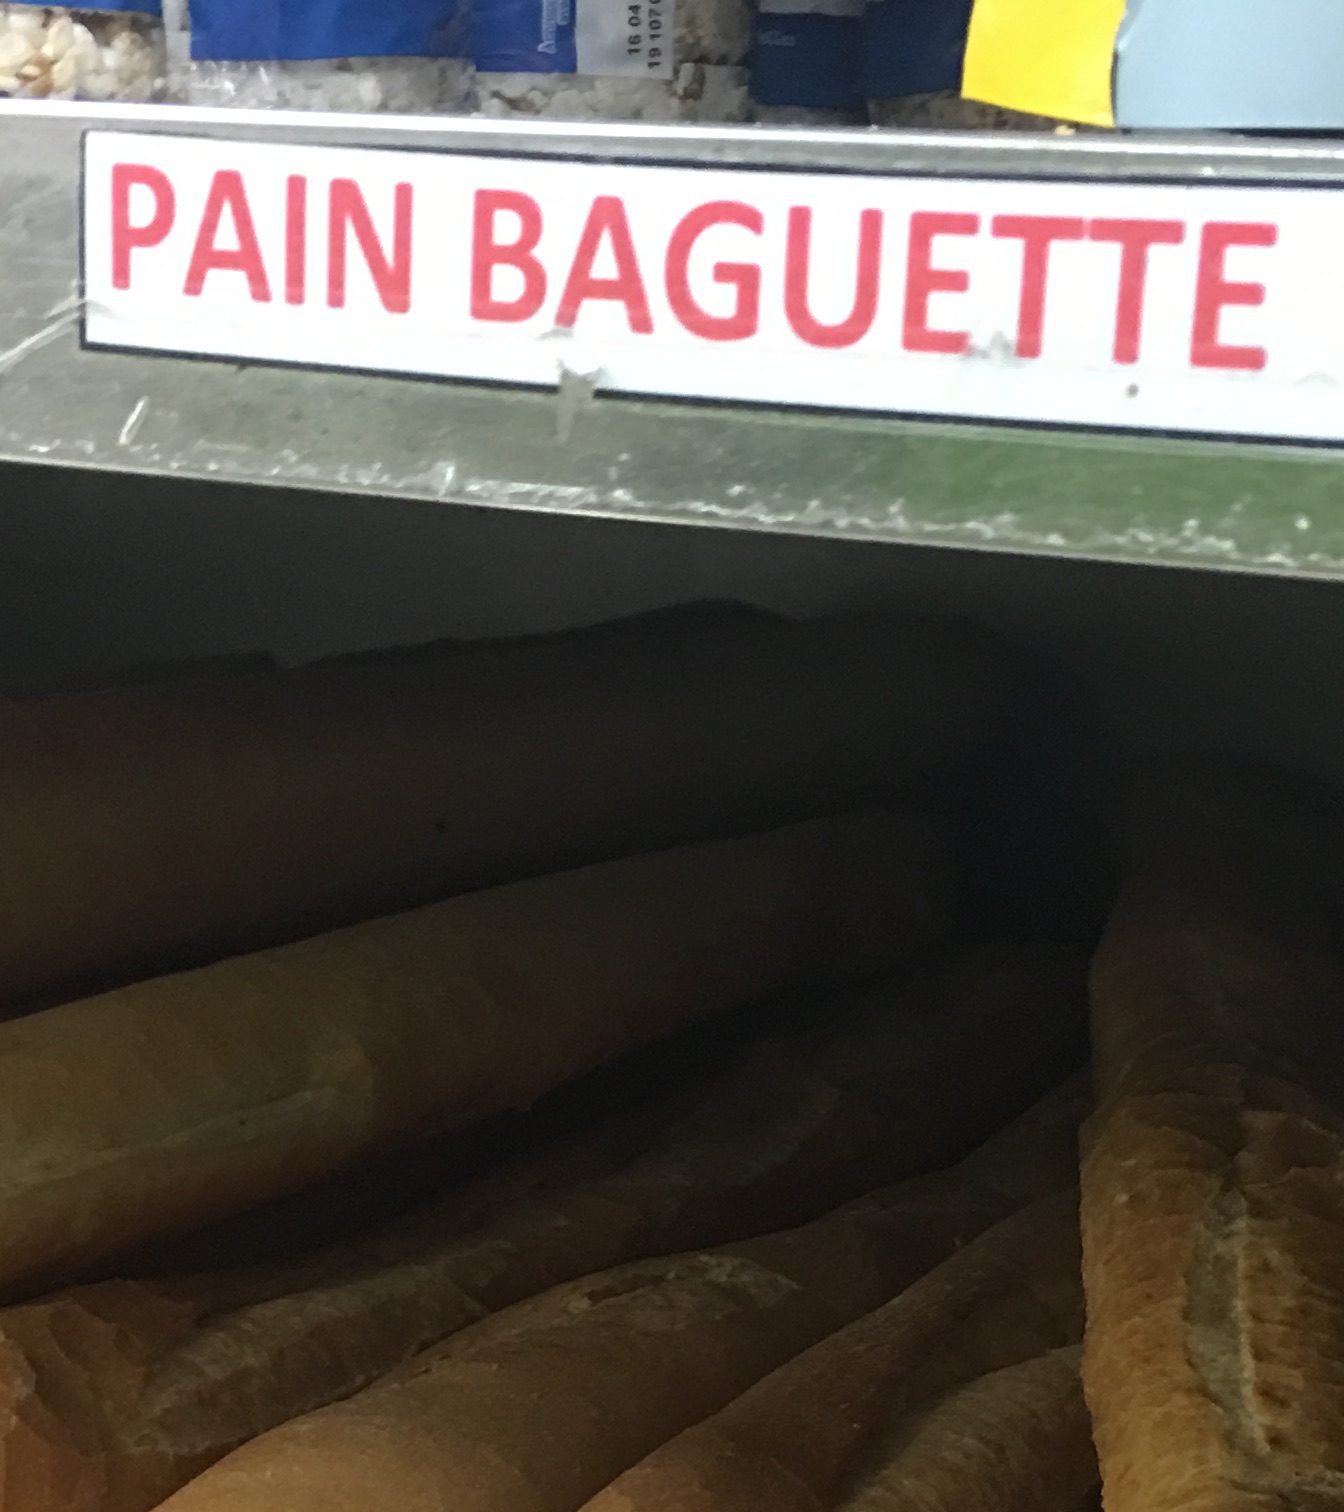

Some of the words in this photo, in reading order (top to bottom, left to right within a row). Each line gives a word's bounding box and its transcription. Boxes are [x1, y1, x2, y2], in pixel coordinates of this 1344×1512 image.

[627, 4, 641, 27] 04
[627, 34, 641, 56] 16
[647, 47, 662, 70] 19
[111, 162, 414, 315] PAIN
[469, 188, 1278, 371] BAGUETTE
